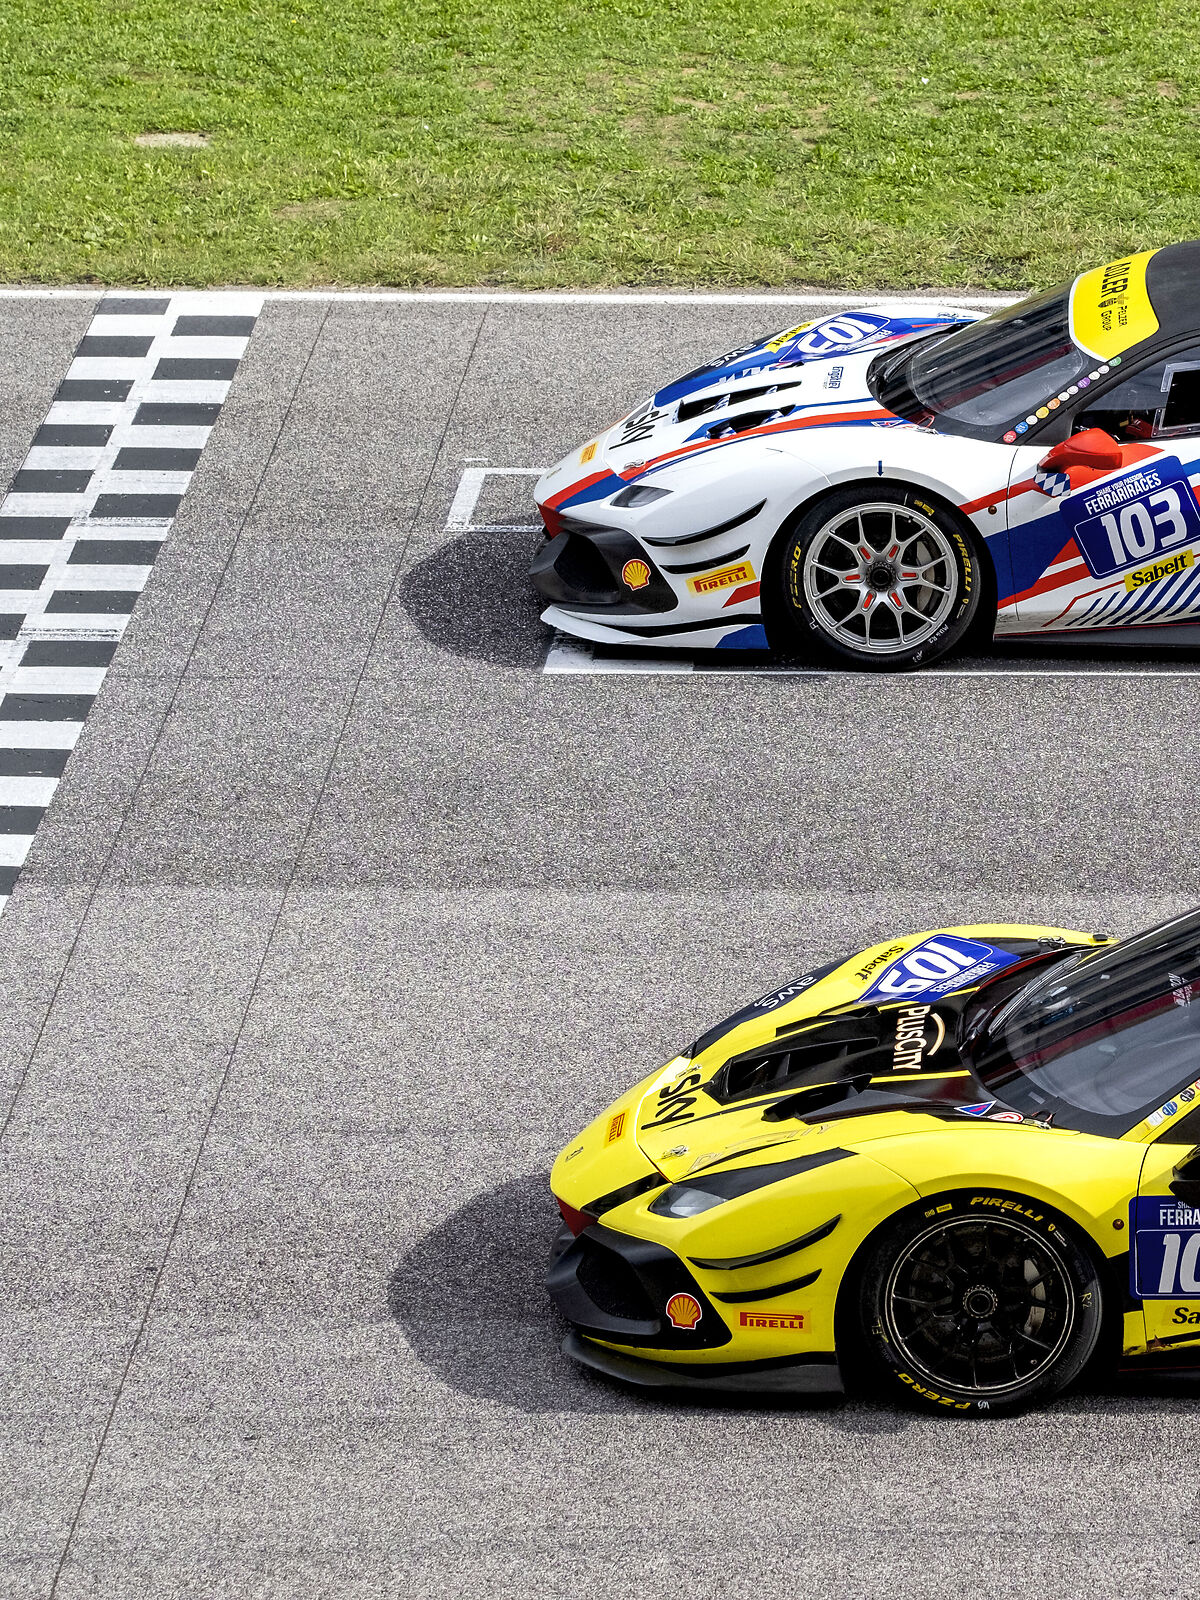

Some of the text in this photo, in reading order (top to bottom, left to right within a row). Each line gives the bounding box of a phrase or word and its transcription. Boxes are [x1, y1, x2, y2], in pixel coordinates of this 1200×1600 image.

[1101, 262, 1131, 298] ADLER
[797, 315, 880, 353] 103
[1084, 473, 1162, 515] FERRARIRACES
[1096, 472, 1144, 496] SHARE YOUR PASSION
[1100, 487, 1188, 566] 103
[694, 566, 748, 593] PIRELLI
[952, 533, 972, 593] PIRELLI
[1131, 553, 1187, 588] Sabelt
[855, 945, 904, 980] Sabelt
[878, 941, 978, 994] 109
[763, 975, 818, 1009] aws
[893, 1004, 930, 1071] PLUSCITY
[641, 1073, 710, 1131] sky
[608, 1112, 625, 1142] PIRELLI
[970, 1196, 1043, 1222] PIRELLI
[739, 1311, 804, 1329] PIRELLI
